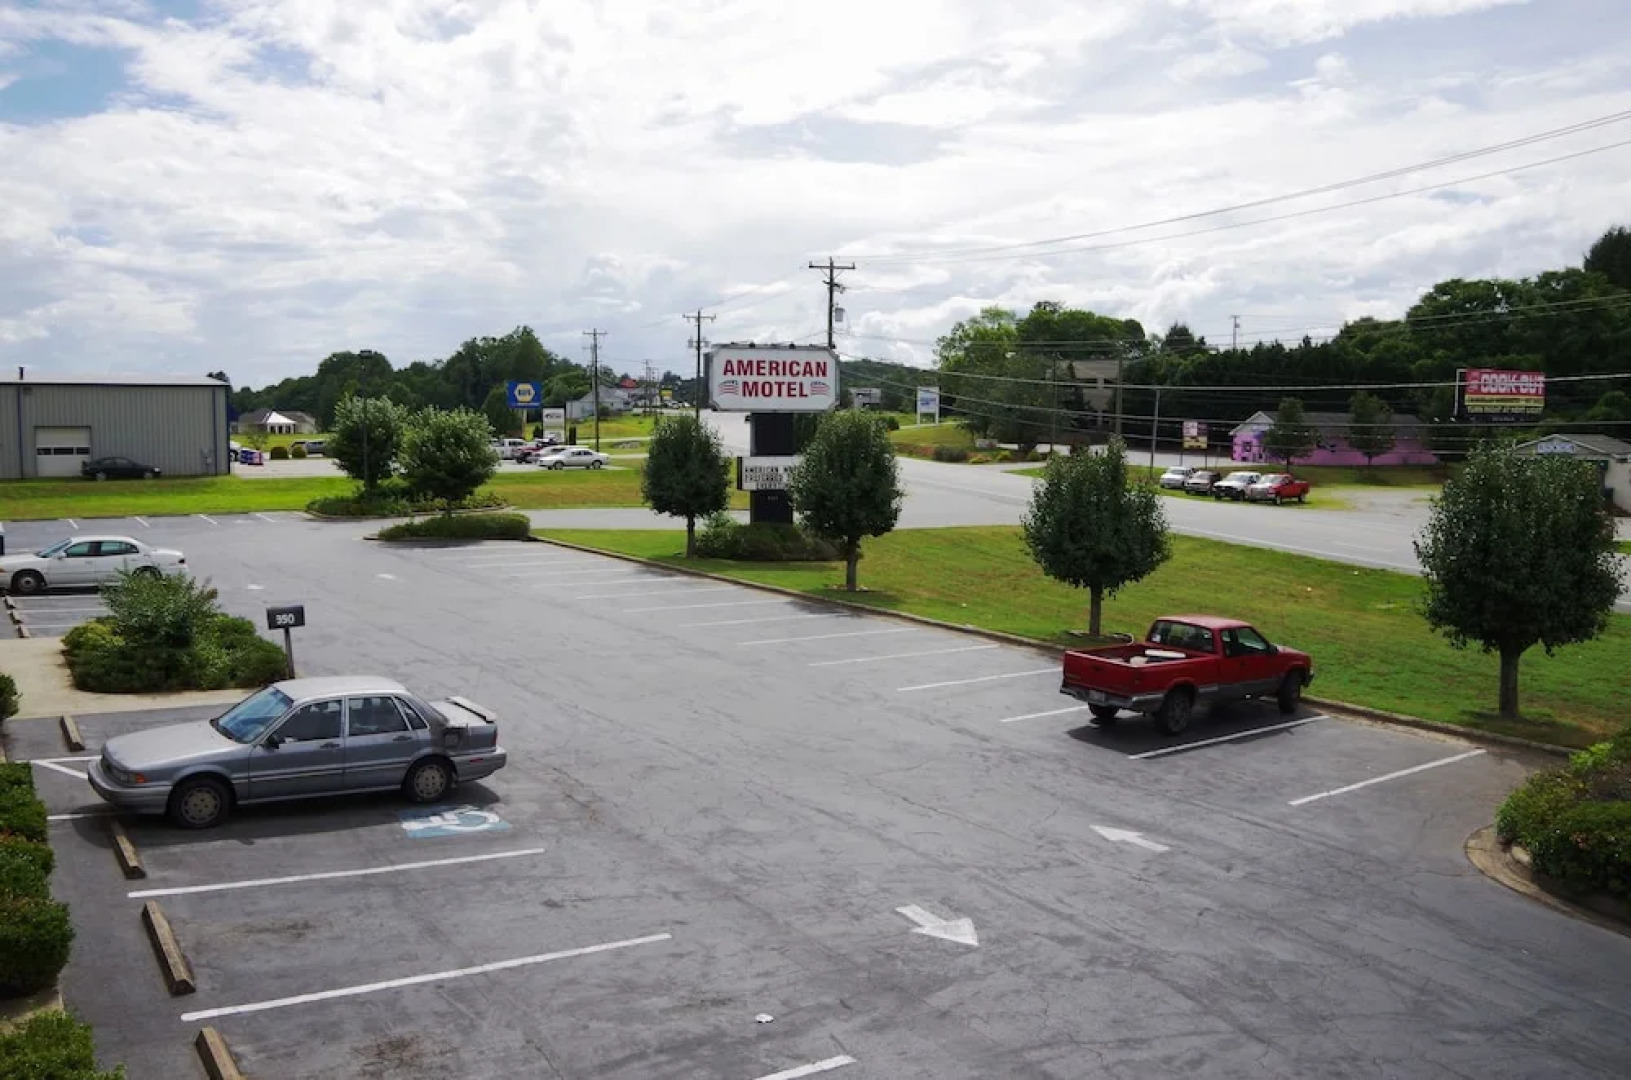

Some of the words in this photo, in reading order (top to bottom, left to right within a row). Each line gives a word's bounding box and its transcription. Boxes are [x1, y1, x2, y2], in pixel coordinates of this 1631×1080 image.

[723, 359, 828, 377] AMERICAN
[741, 381, 809, 398] MOTEL
[744, 465, 779, 474] AMERICAN
